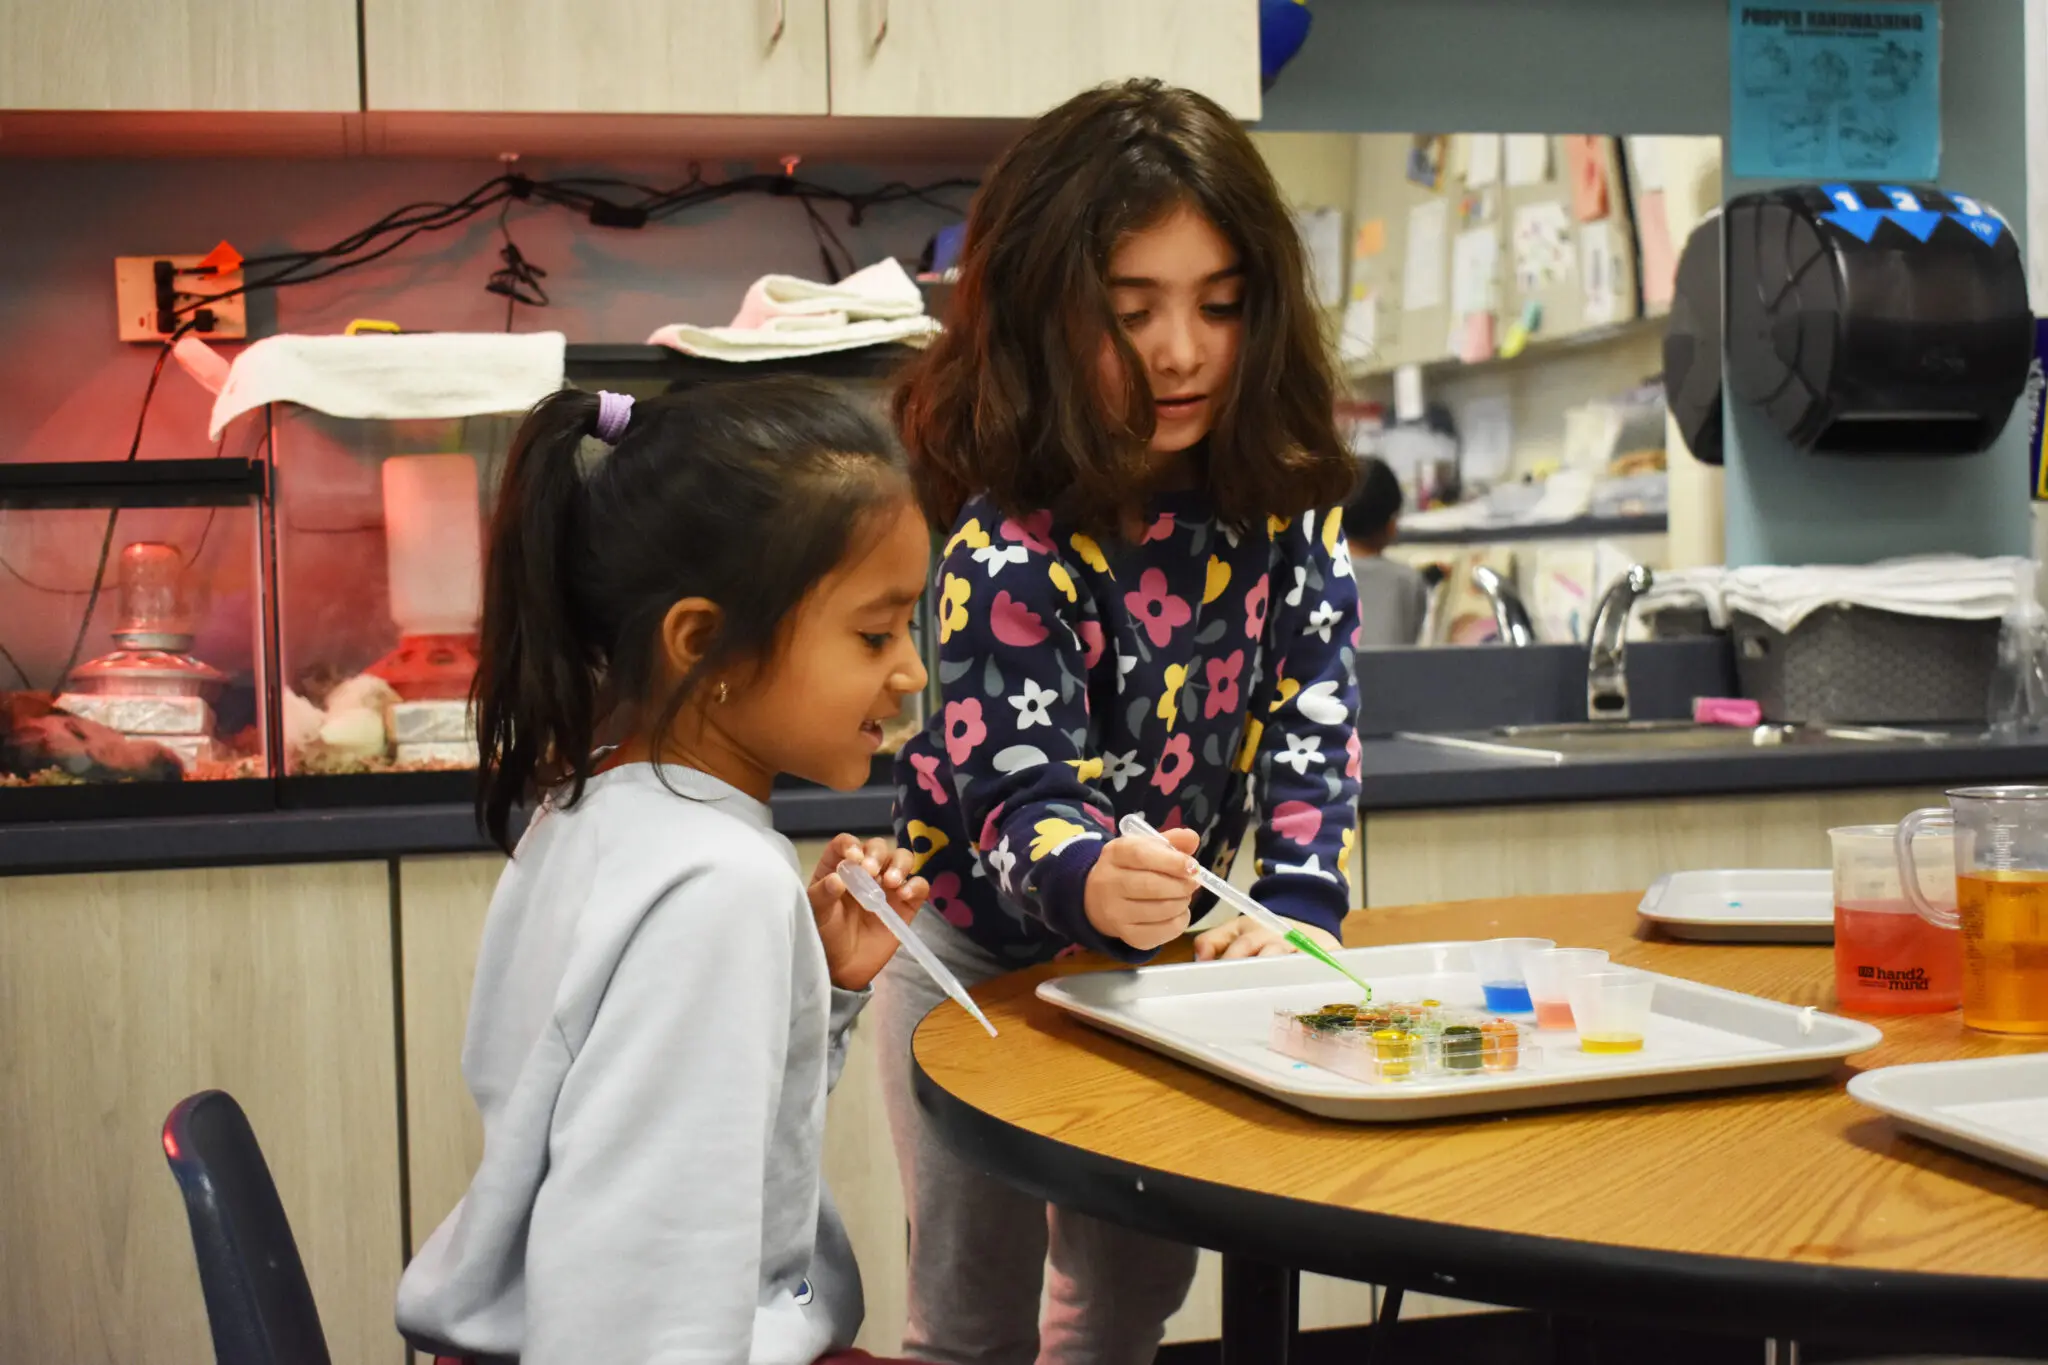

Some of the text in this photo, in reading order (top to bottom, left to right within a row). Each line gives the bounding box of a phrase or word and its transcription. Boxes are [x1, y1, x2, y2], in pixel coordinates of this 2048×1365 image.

[1834, 191, 1860, 211] 1
[1891, 191, 1920, 212] 2
[1877, 967, 1925, 981] hand2
[1888, 977, 1929, 990] mind
